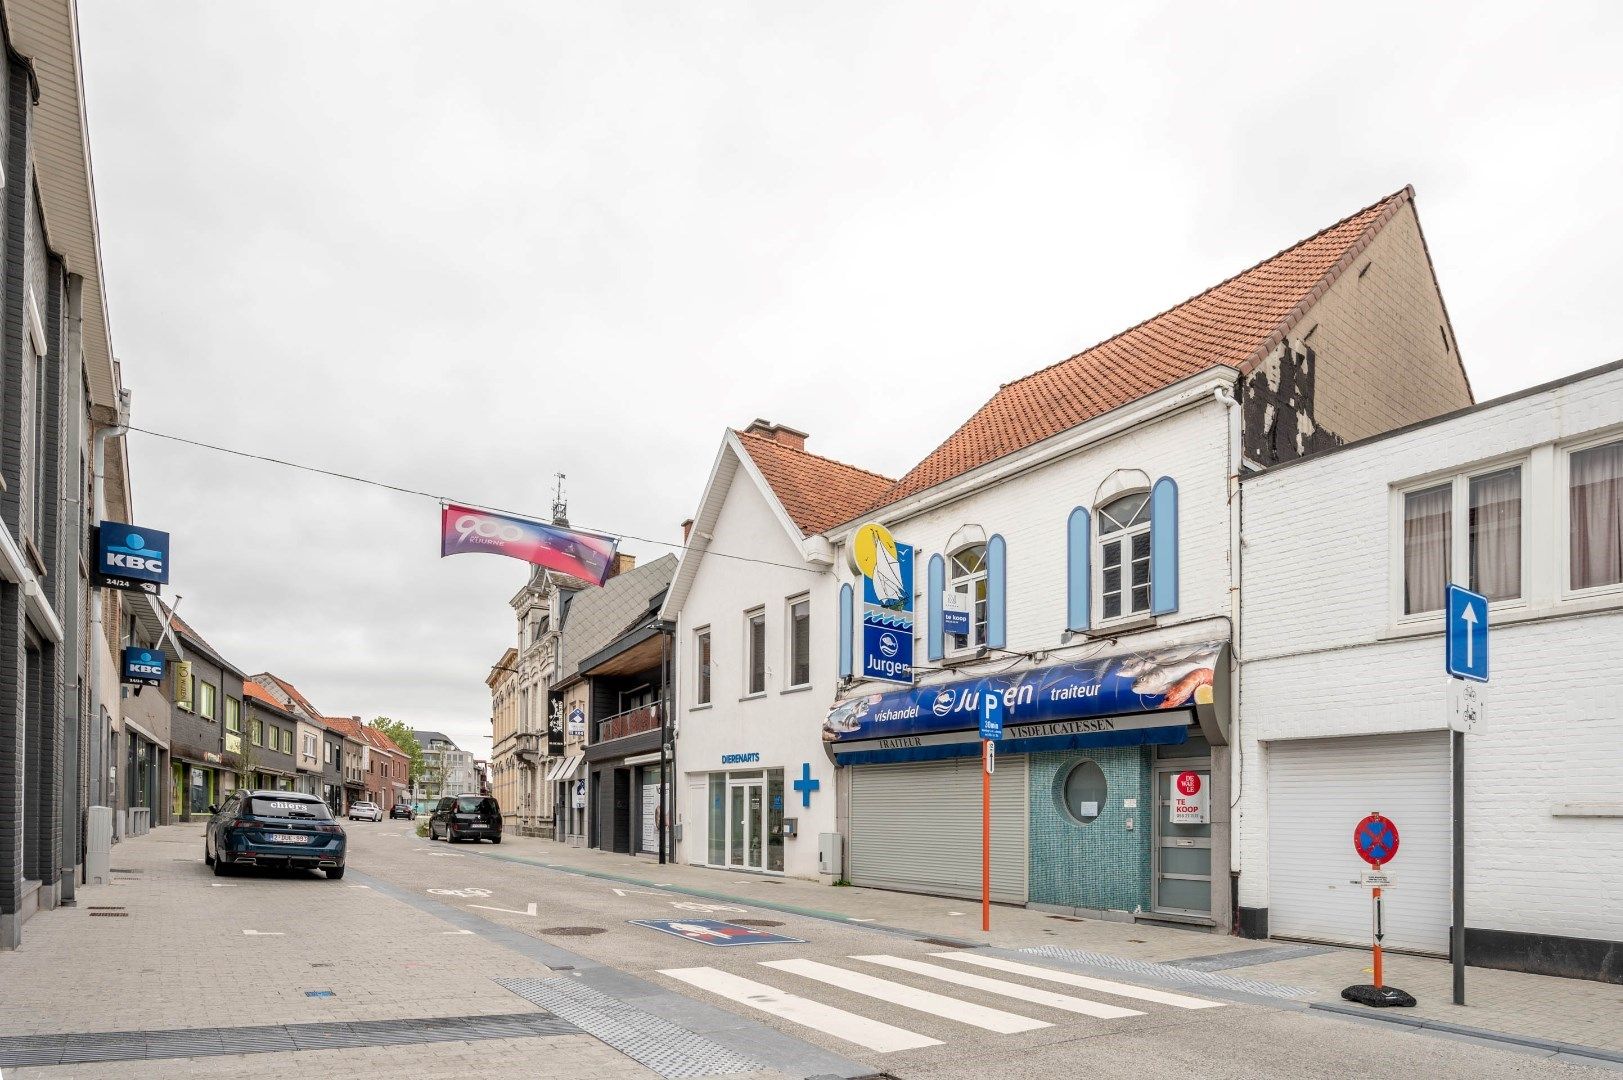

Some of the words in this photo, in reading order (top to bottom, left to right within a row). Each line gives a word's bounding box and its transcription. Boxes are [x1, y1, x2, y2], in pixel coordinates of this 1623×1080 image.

[455, 514, 523, 547] 900
[470, 536, 505, 547] KUURNE
[106, 552, 162, 574] KBC
[106, 578, 130, 588] 24/24
[953, 615, 967, 623] koop
[129, 663, 162, 675] KBC
[874, 704, 920, 723] vishandel
[955, 685, 1034, 713] Juen
[1050, 684, 1102, 701] traiteur
[985, 693, 998, 719] P
[879, 737, 922, 749] TRAITEUR
[1009, 718, 1116, 739] VISDELICATESSEN
[721, 752, 760, 764] DIERENARTS
[1176, 798, 1186, 806] TE
